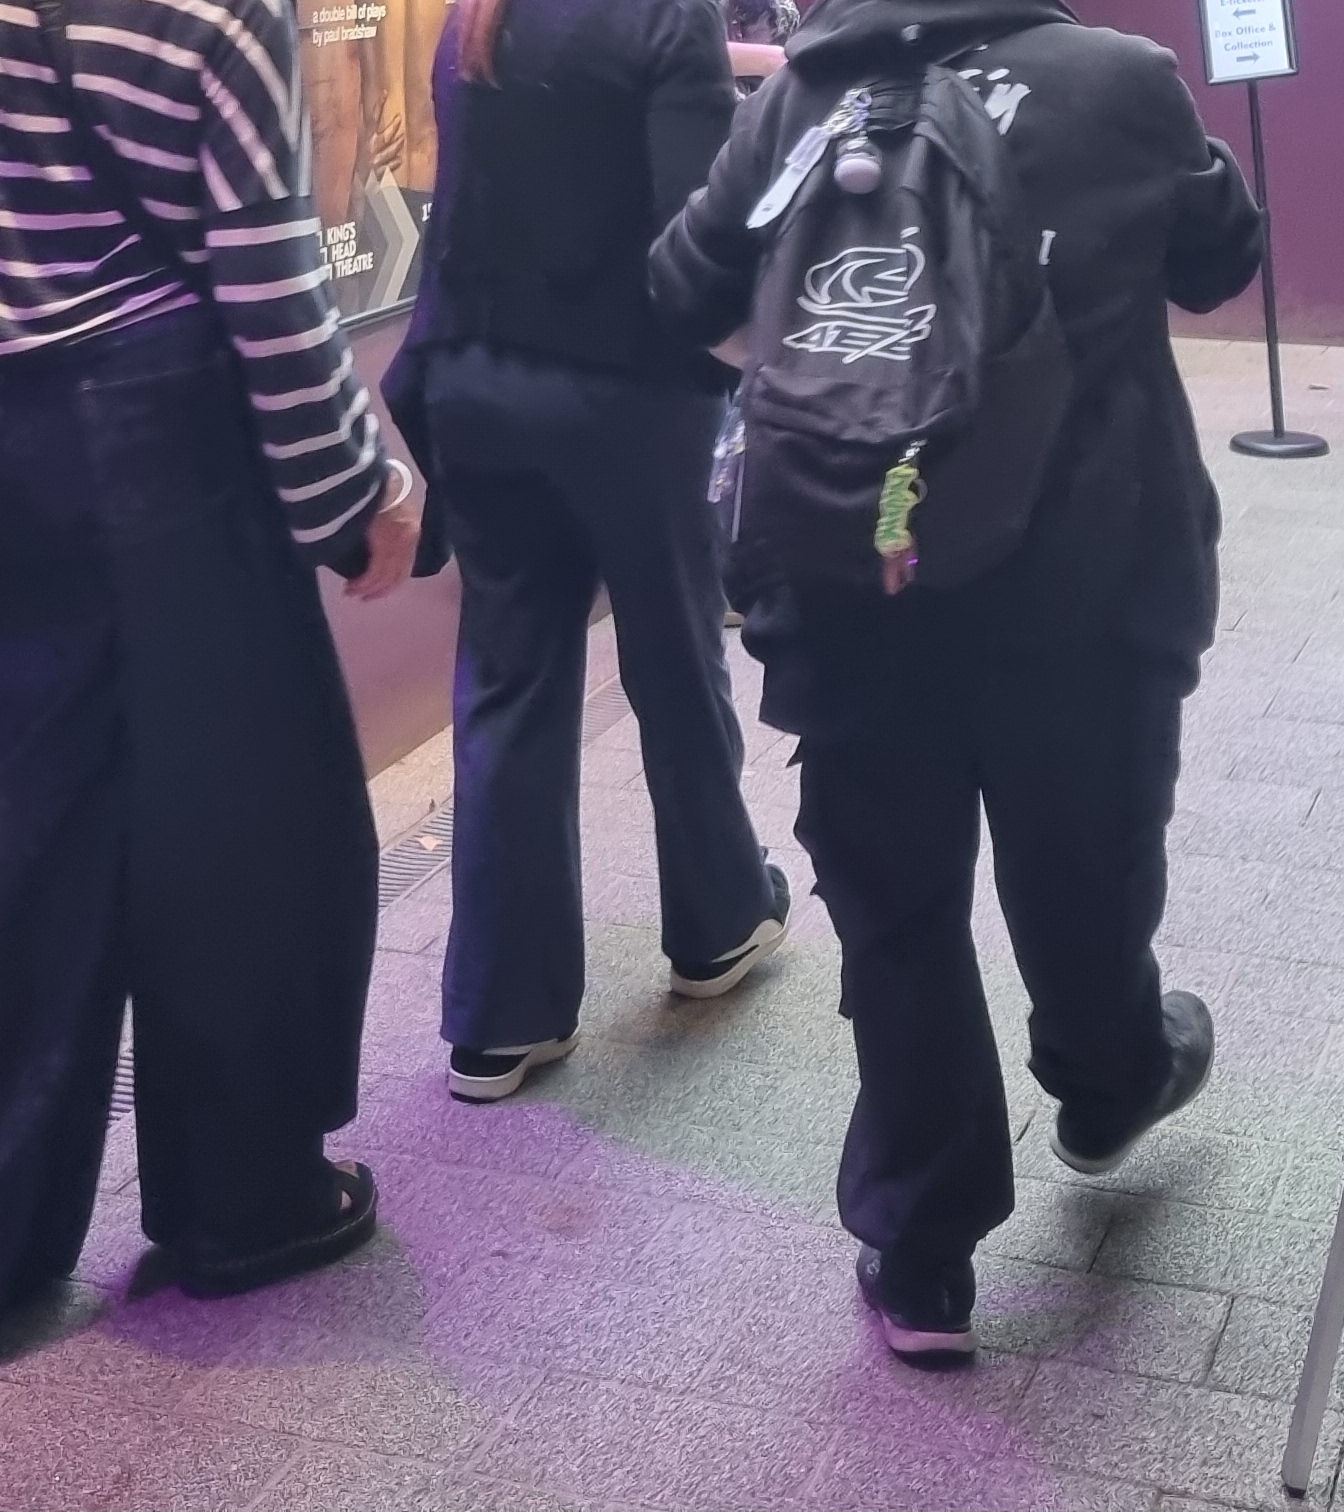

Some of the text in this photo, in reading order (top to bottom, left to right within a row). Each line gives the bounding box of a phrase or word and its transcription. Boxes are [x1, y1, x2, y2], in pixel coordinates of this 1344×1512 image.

[312, 2, 387, 24] a double bill of plays
[312, 29, 324, 47] by
[324, 26, 340, 46] paul
[1224, 40, 1273, 51] Collection
[331, 240, 357, 262] HEAD
[334, 251, 374, 279] THEATRE
